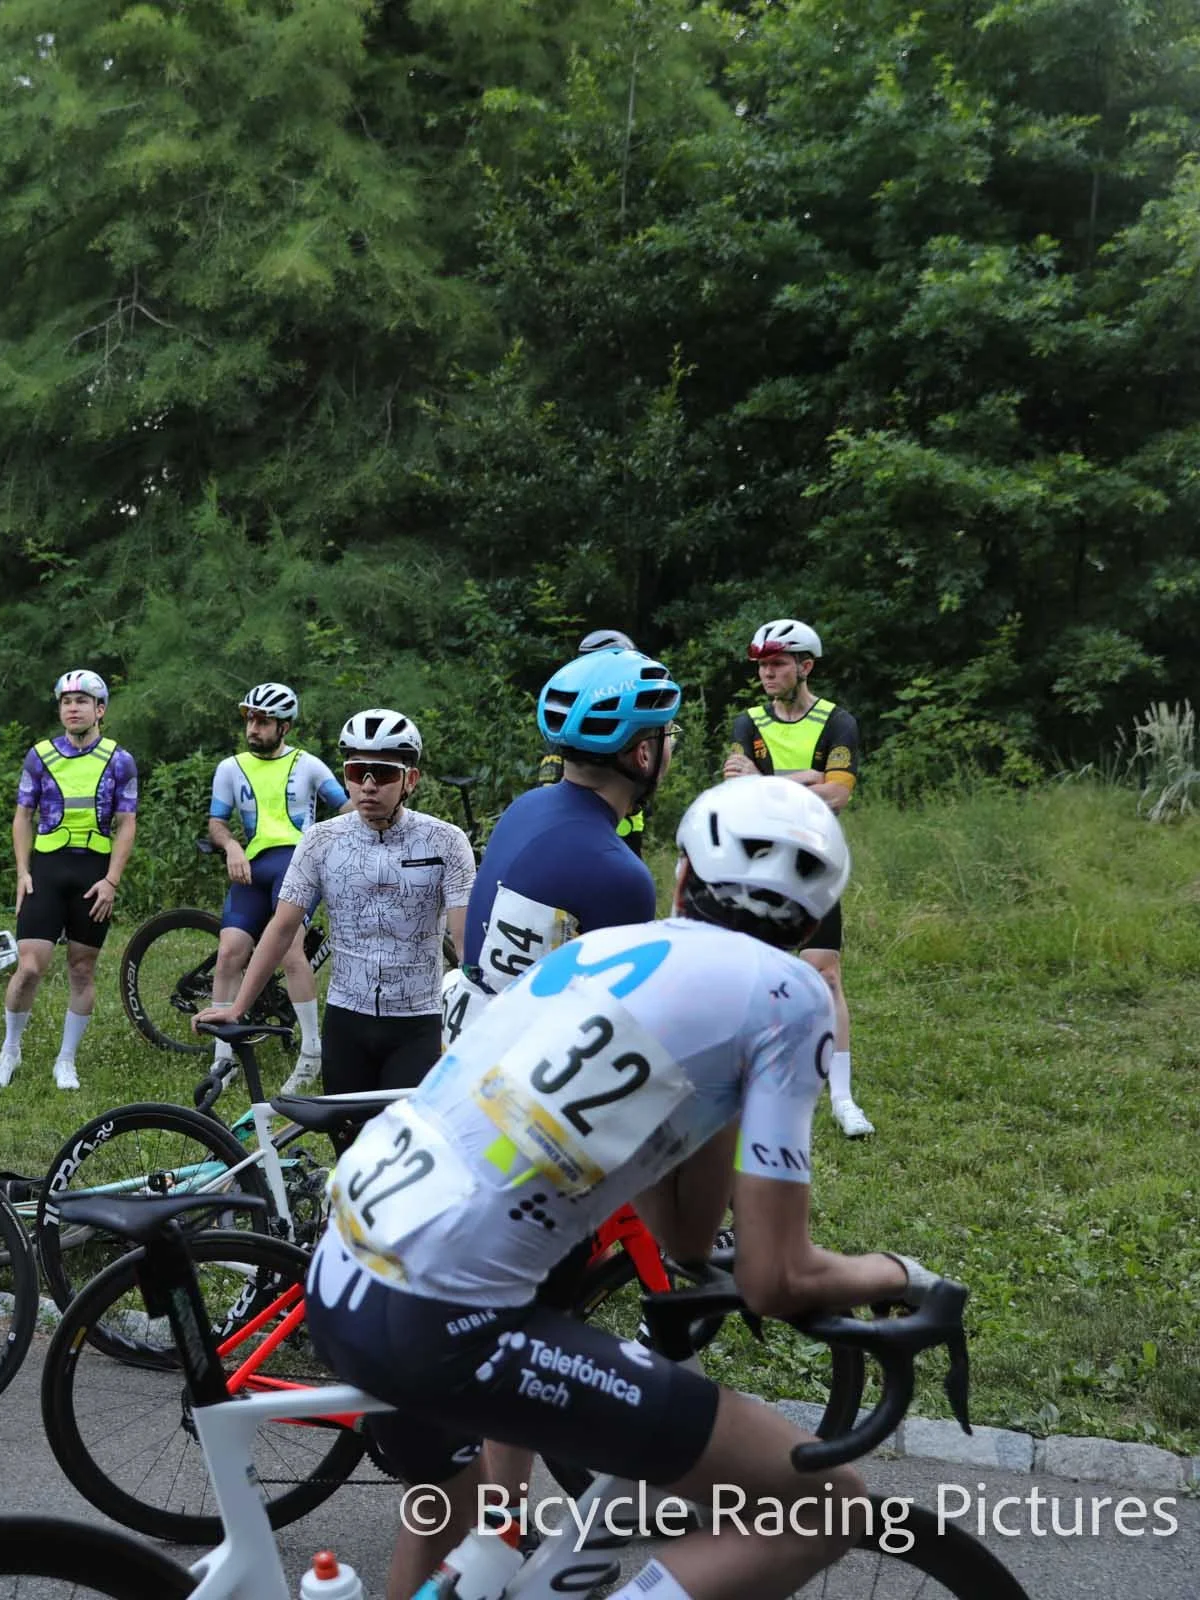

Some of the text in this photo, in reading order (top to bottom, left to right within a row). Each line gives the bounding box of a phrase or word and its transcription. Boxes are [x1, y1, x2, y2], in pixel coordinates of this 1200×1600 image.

[489, 919, 544, 977] 64
[529, 1014, 651, 1137] 32
[347, 1127, 435, 1230] 32
[445, 1308, 498, 1336] GOBIK
[517, 1368, 571, 1408] Tech
[529, 1338, 643, 1407] Telefónica
